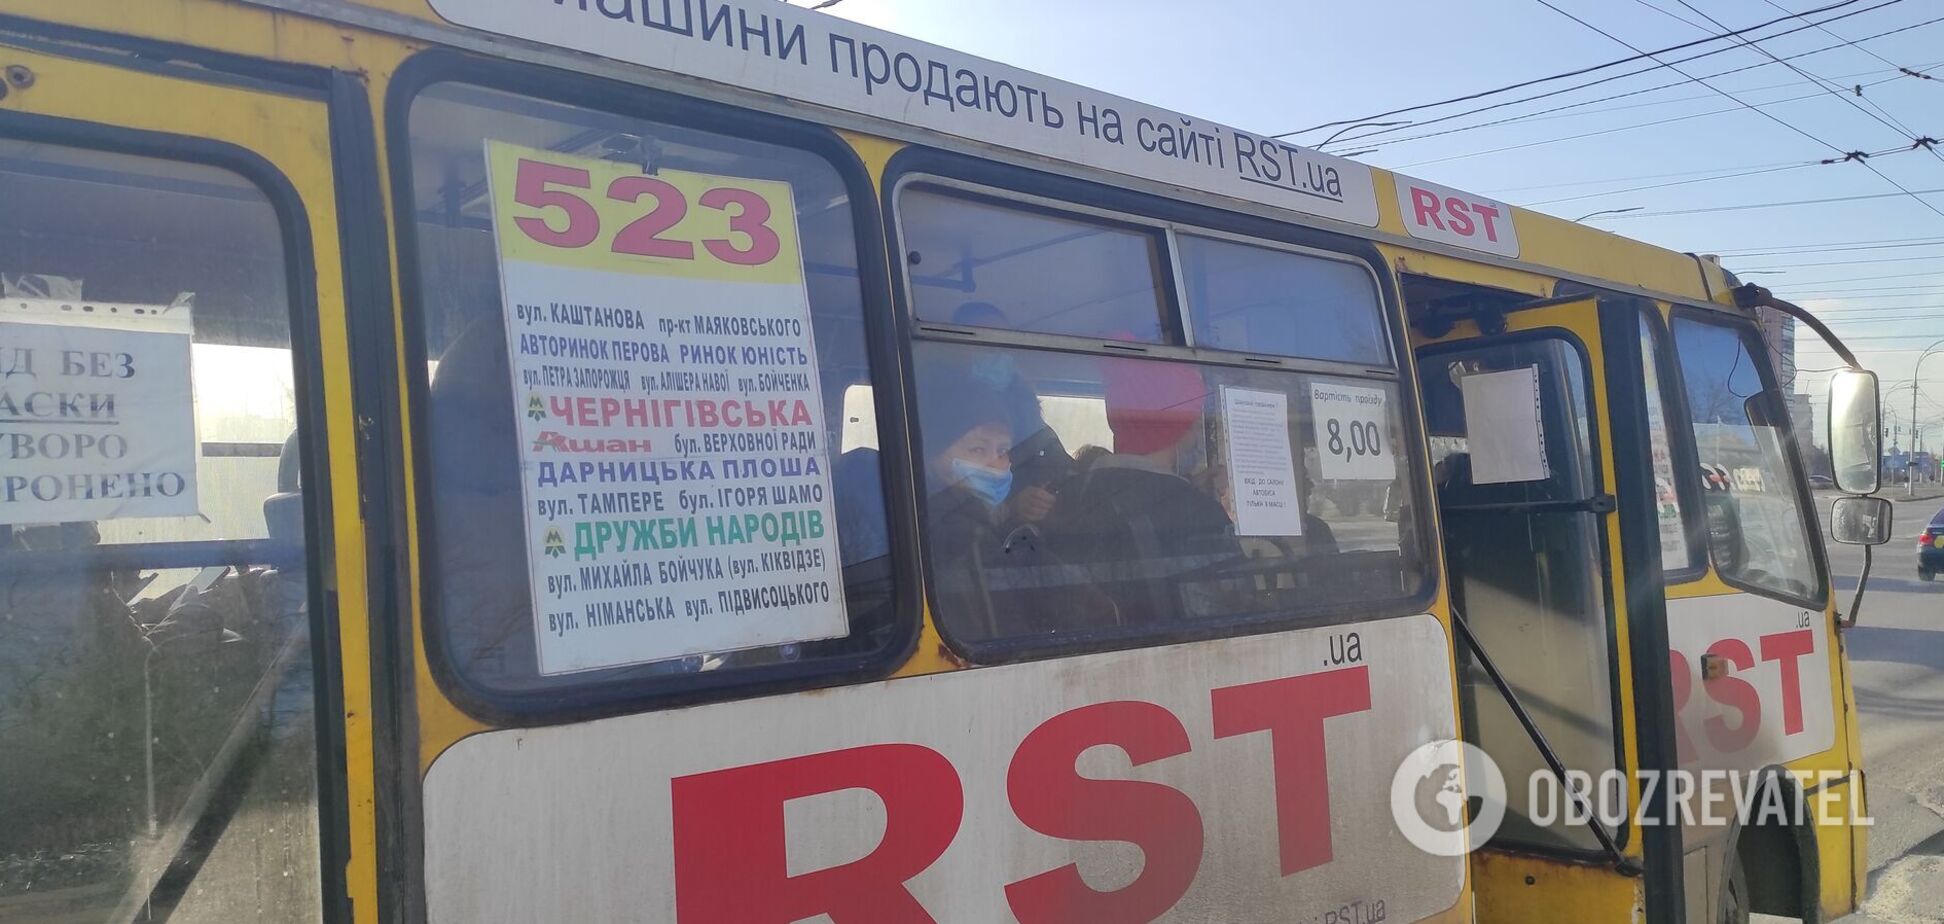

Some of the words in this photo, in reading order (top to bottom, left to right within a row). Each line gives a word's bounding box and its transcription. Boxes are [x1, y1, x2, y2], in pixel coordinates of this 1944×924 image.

[554, 0, 808, 66] шини
[830, 37, 1064, 129] продають
[1078, 104, 1125, 145] на
[1137, 116, 1225, 169] сайті
[1237, 133, 1343, 198] RST.ua
[513, 158, 781, 266] 523
[1410, 186, 1499, 243] RST
[516, 303, 547, 326] вул.
[550, 302, 645, 330] КАШТАНОВА
[658, 316, 691, 338] пр-кт
[694, 316, 801, 337] МАЯКОВСЬКОГО
[0, 346, 36, 380] Д
[60, 350, 136, 379] БЕЗ
[520, 333, 609, 361] АВТОРИНОК
[612, 341, 670, 364] ПЕРОВА
[680, 344, 737, 365] РИНОК
[741, 345, 808, 366] ЮНІСТЬ
[523, 368, 541, 390] вул.
[543, 366, 573, 387] ПЕТРА
[574, 367, 631, 392] ЗАПОРОЖЦЯ
[641, 375, 659, 395] вул.
[660, 371, 701, 392] АЛІШЕРА
[702, 369, 730, 392] НАВОЇ
[738, 377, 757, 396] вул.
[759, 369, 811, 392] БОЙЧЕНКА
[550, 396, 813, 427] ЧЕРНІГІВСЬКА
[0, 432, 128, 459] ВОРО
[532, 431, 652, 453] Ашан
[674, 433, 701, 458] бул.
[703, 430, 779, 453] ВЕРХОВНОЇ
[781, 431, 817, 454] РАДИ
[1327, 418, 1381, 463] 8,00
[0, 471, 186, 502] РОНЕНО
[537, 461, 715, 488] ДАРНИЦЬКА
[722, 457, 821, 479] ПЛОША
[538, 499, 574, 521] вул.
[577, 491, 665, 515] ТАМПЕРЕ
[679, 489, 714, 514] бул.
[718, 486, 768, 508] ІГОРЯ
[772, 483, 823, 506] ШАМО
[574, 517, 699, 561] ДРУЖБИ
[706, 510, 825, 547] НАРОДІВ
[548, 574, 577, 599] вул.
[580, 559, 653, 591] МИХАЙЛА
[658, 555, 724, 584] БОЙЧУКА
[728, 555, 759, 580] (вул.
[761, 548, 826, 572] КІКВІДЗЕ)
[549, 611, 579, 637] вул.
[586, 596, 676, 628] НІМАНСЬКА
[685, 598, 713, 622] вул.
[718, 581, 830, 616] ПІДВИСОЦЬКОГО
[1796, 610, 1811, 629] .ua
[1323, 632, 1363, 667] .ua
[671, 665, 1372, 924] RST
